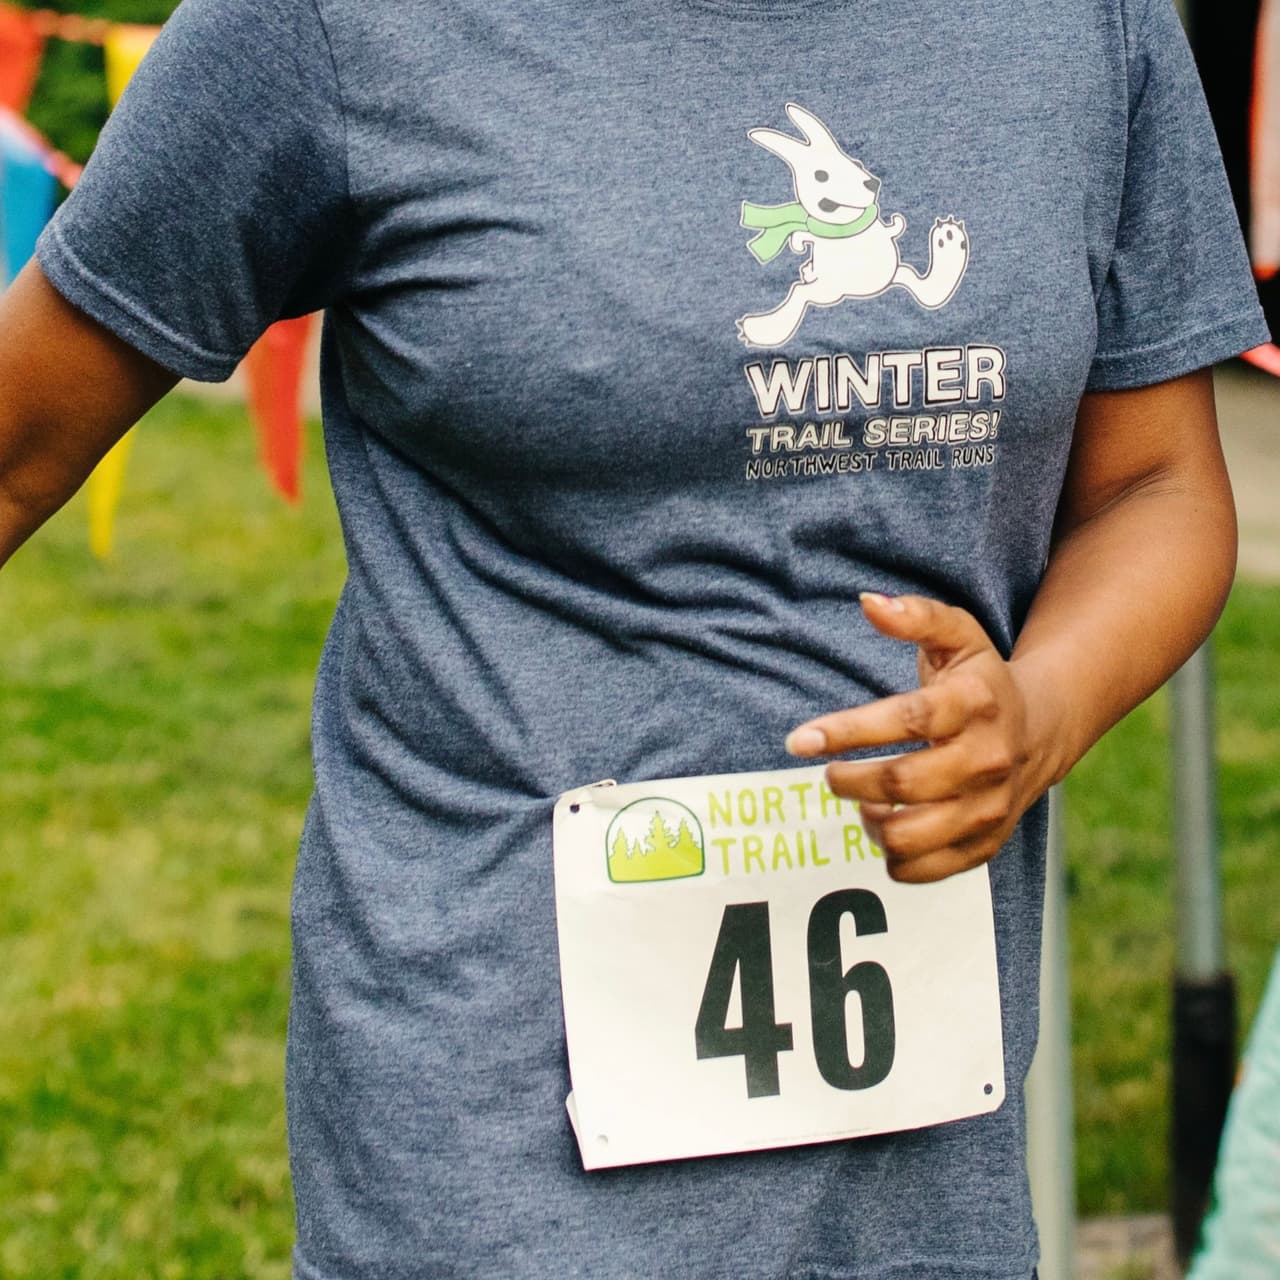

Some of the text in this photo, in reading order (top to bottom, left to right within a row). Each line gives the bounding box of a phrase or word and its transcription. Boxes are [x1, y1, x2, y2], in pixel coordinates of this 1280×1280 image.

[744, 344, 1006, 417] WINTER
[746, 410, 1001, 454] TRAIL SERIES!
[746, 444, 995, 480] NORTHWEST TRAIL RUNS
[707, 782, 860, 828] NORTH
[711, 830, 830, 875] TRAIL
[695, 887, 896, 1099] 46
